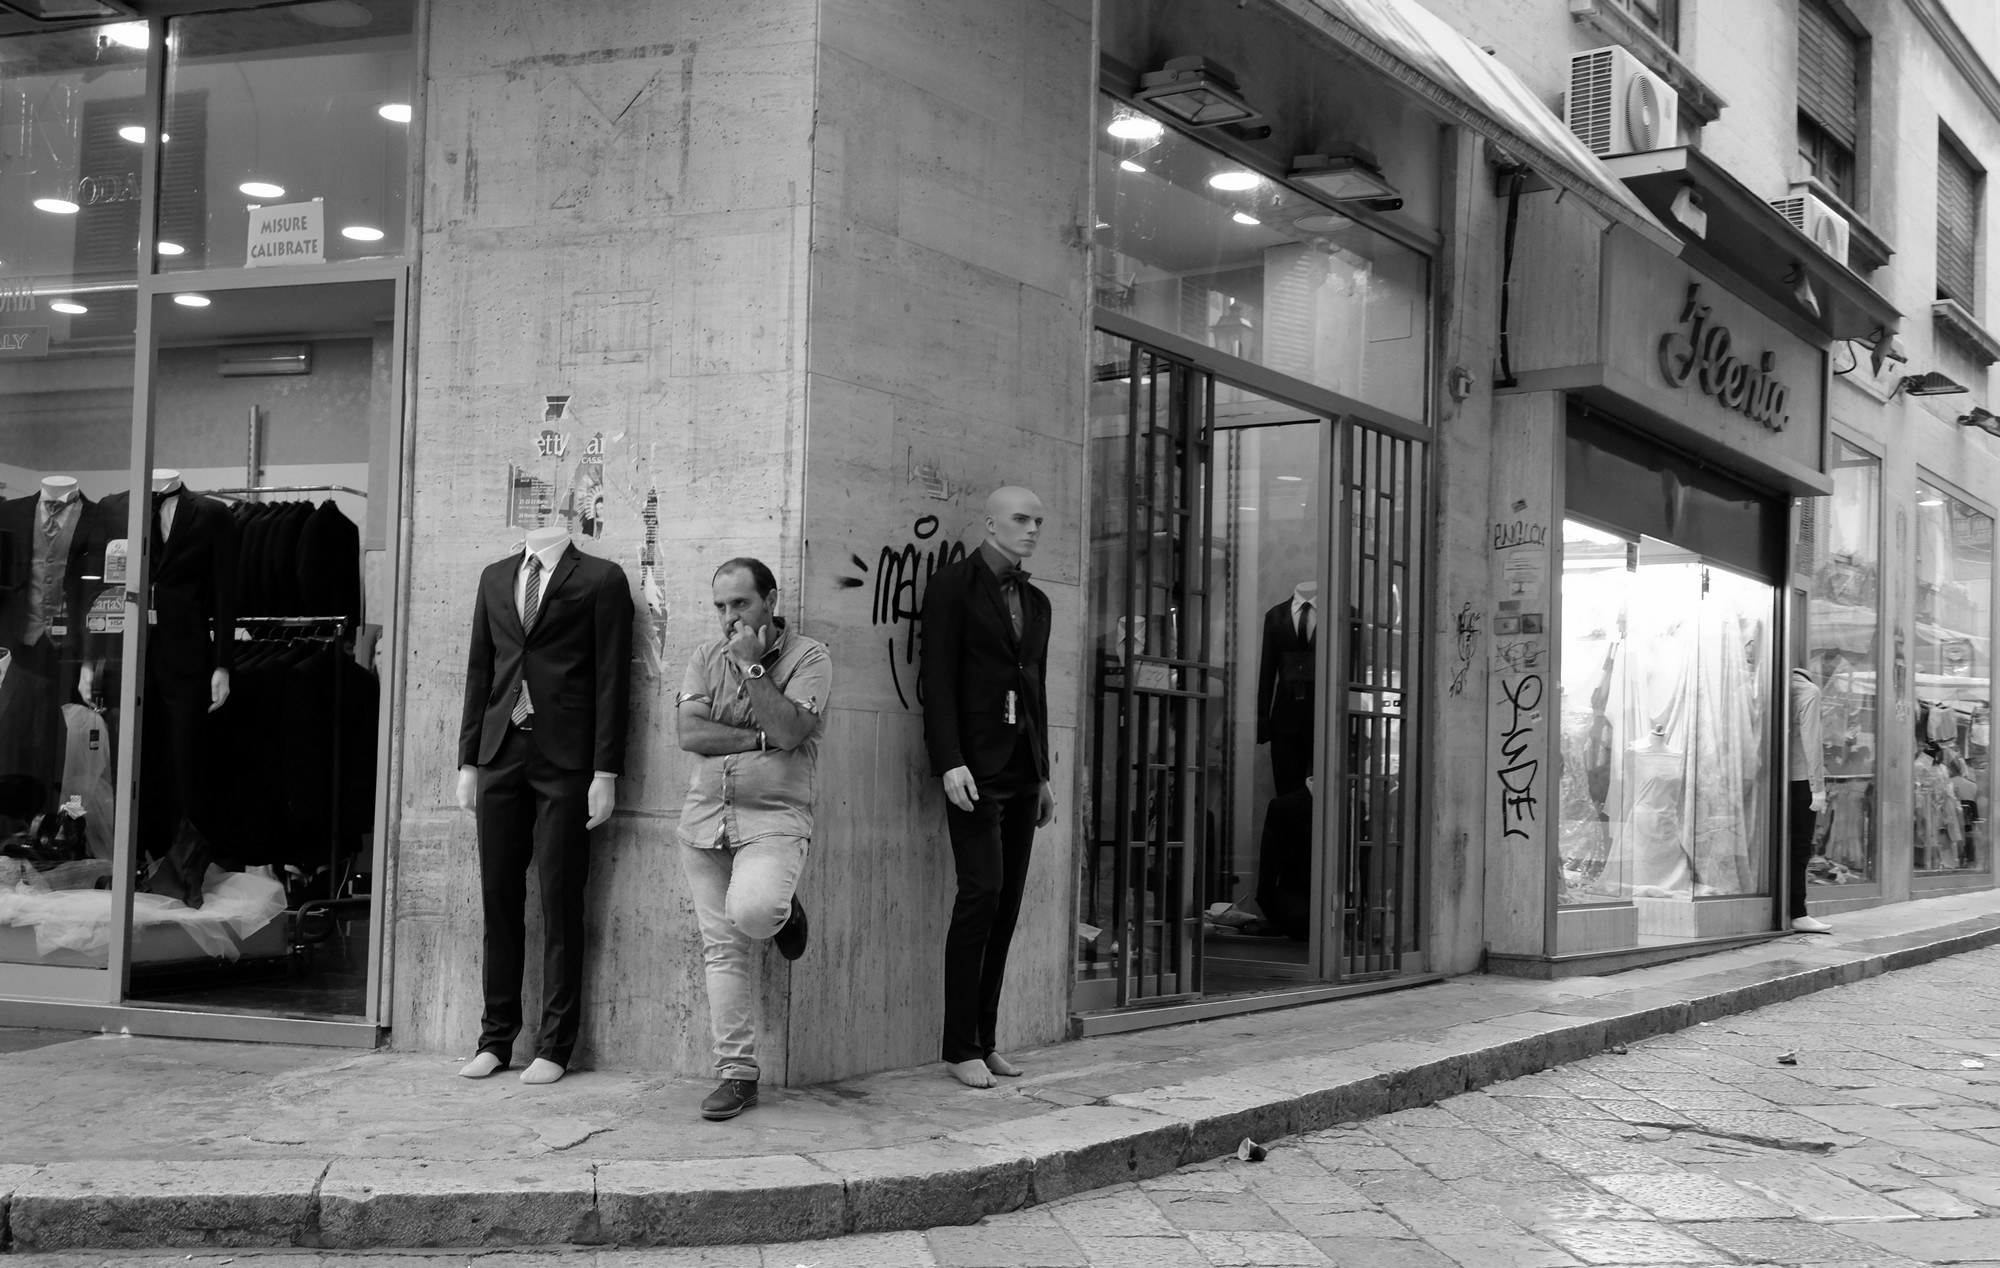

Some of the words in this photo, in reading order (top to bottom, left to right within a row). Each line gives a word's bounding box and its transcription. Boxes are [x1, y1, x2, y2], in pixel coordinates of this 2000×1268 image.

[261, 216, 307, 234] MISURE
[251, 239, 318, 258] CALIBRATE
[0, 333, 28, 350] LY
[536, 434, 569, 456] etty
[582, 456, 603, 464] CASS
